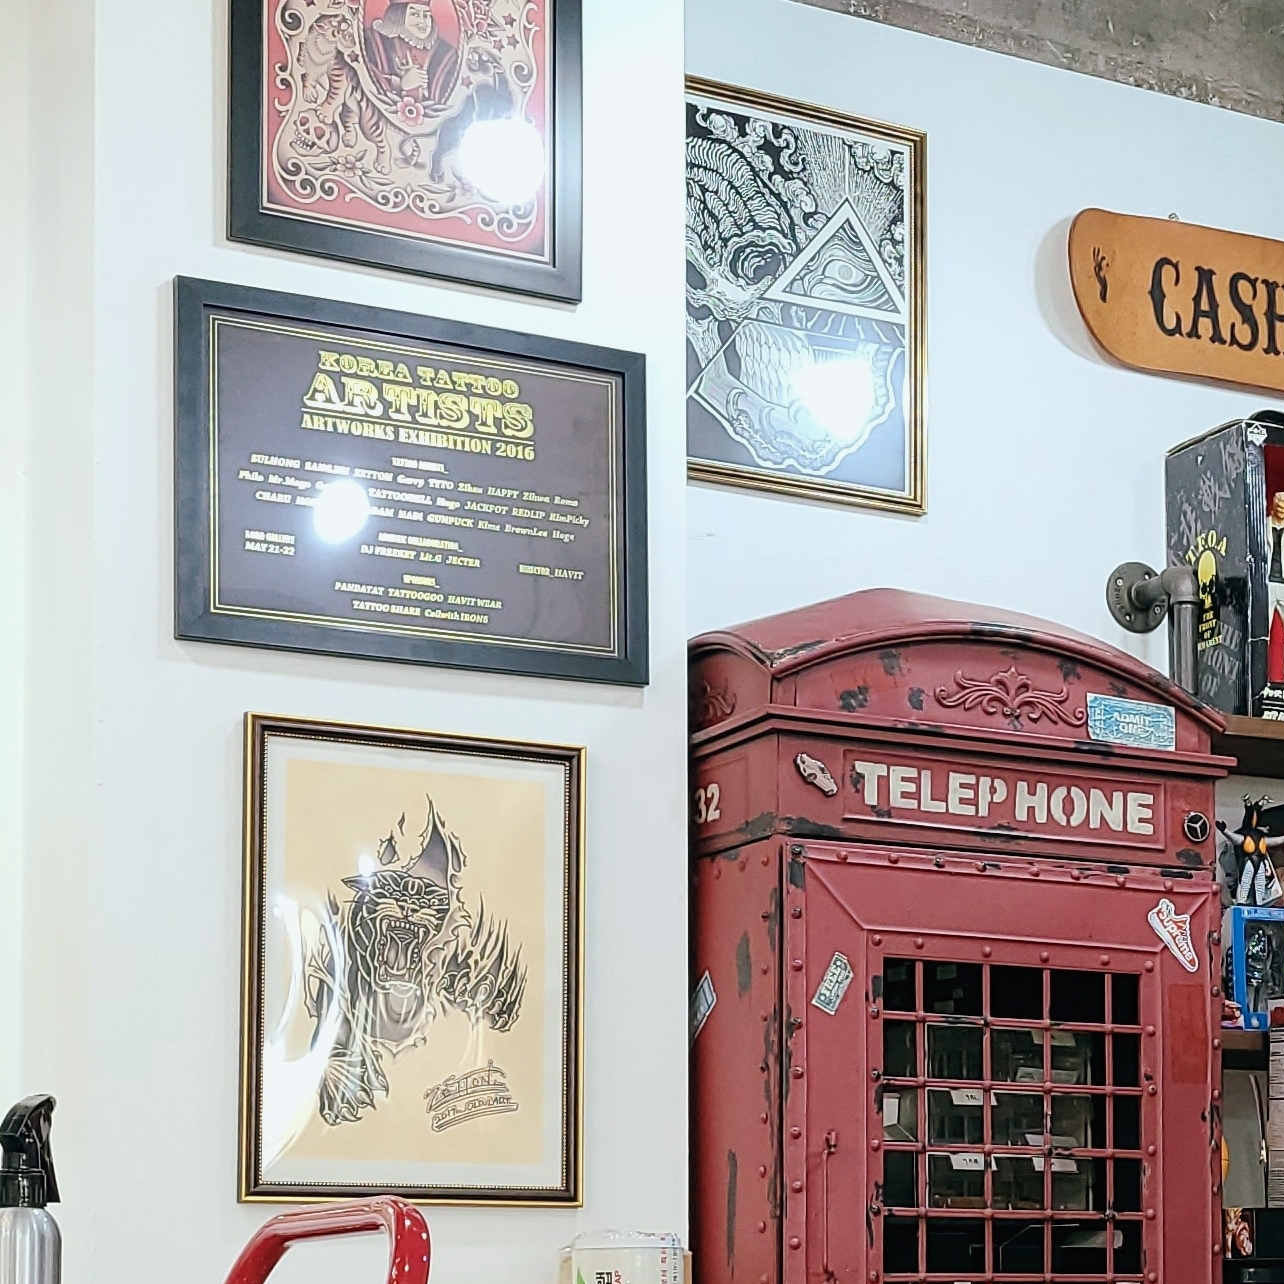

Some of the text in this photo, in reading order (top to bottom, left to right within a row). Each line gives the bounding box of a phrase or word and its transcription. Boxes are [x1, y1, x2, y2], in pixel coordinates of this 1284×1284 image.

[319, 350, 519, 399] KOREA TATTOO
[303, 372, 534, 439] ARTISTS
[301, 413, 535, 461] ARTWORKS EXHIBITION 2016
[464, 501, 509, 515] JACKPOT
[512, 508, 546, 520] REDLIP
[854, 760, 1154, 836] TELEPHONE
[1158, 909, 1194, 961] Supreme
